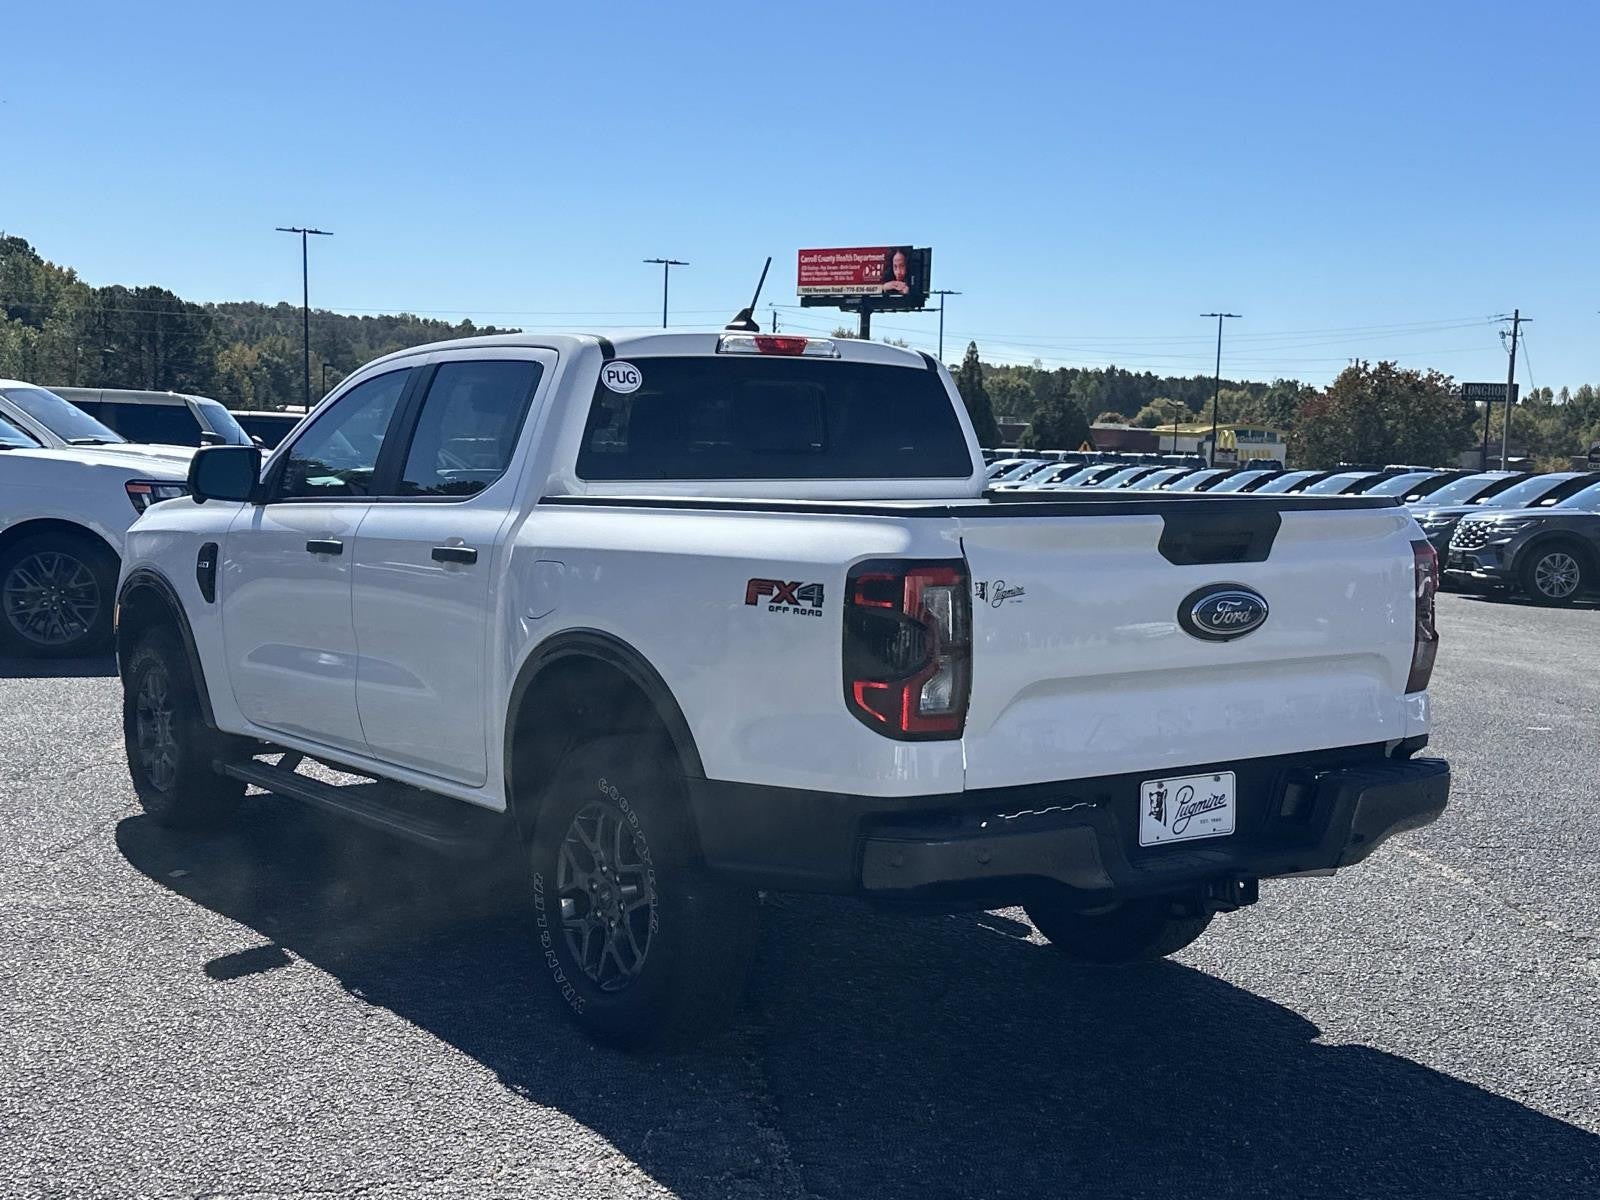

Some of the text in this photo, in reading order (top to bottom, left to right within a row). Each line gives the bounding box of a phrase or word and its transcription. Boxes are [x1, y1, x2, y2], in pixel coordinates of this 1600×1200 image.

[818, 254, 835, 265] County
[836, 253, 853, 262] Health
[854, 253, 885, 263] Department
[607, 370, 637, 384] PUG
[1462, 384, 1510, 396] LONGHOR
[745, 578, 824, 608] FX4
[768, 605, 823, 617] OFF ROAD
[1212, 600, 1253, 625] Ford
[1172, 785, 1228, 835] Pugmire
